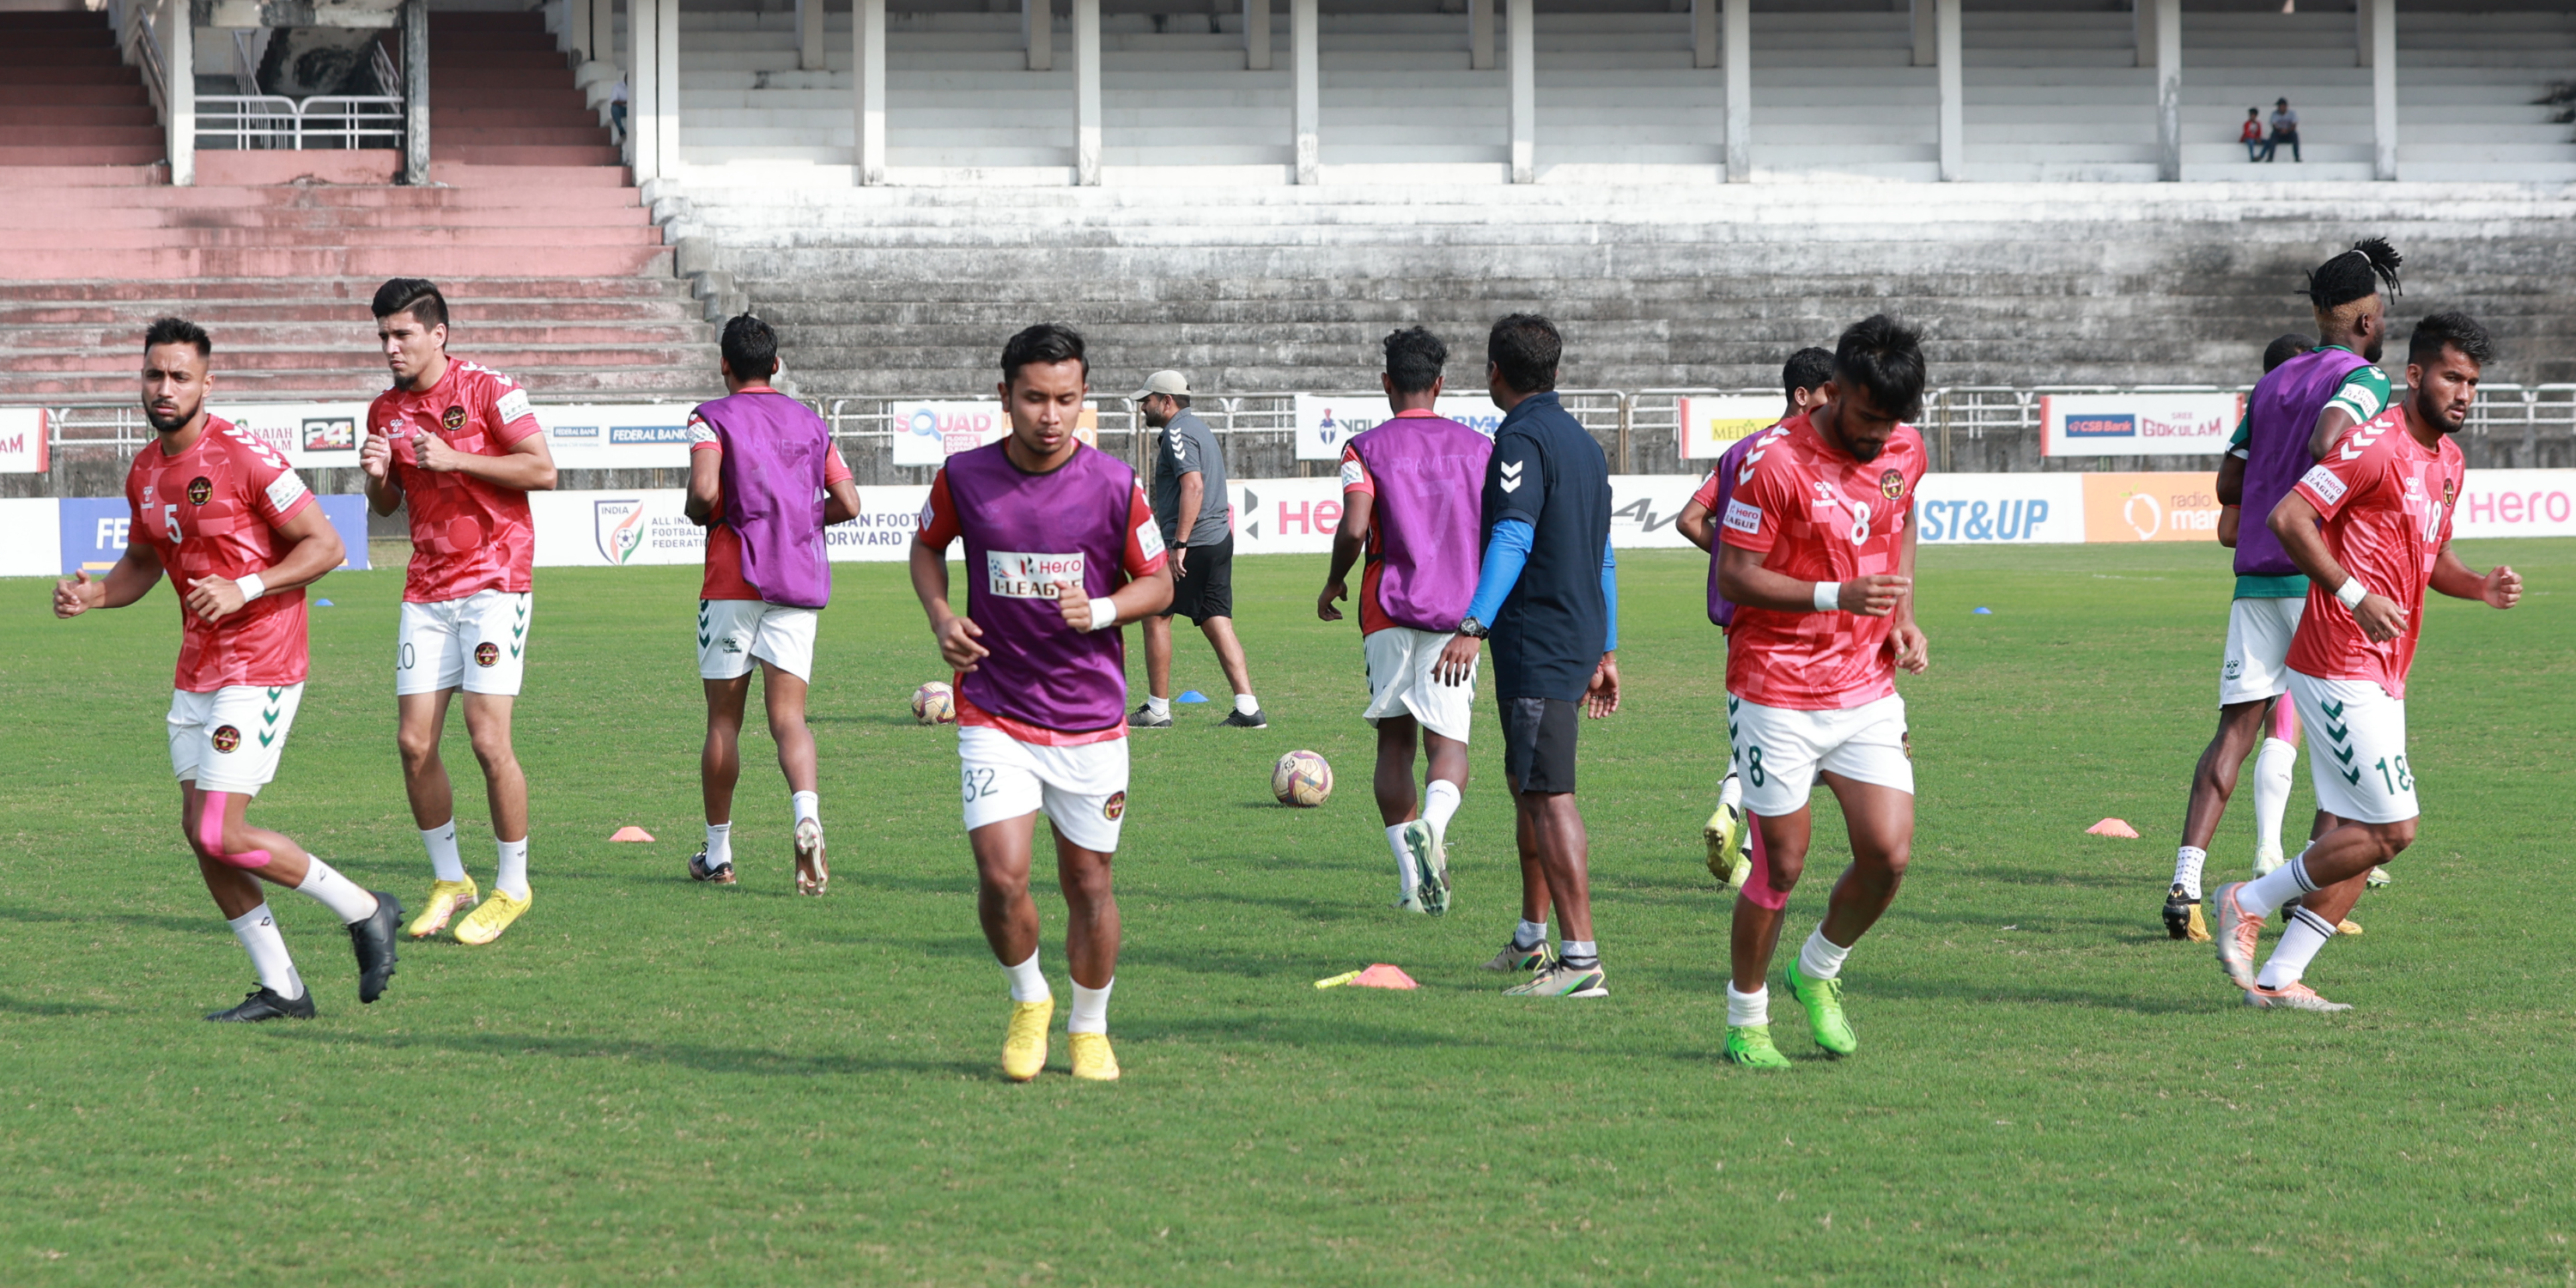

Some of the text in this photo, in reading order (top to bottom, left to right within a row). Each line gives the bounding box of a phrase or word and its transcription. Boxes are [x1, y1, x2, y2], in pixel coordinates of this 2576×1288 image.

[305, 421, 352, 445] 24
[612, 429, 656, 441] FEDERAL
[657, 428, 688, 440] BANK
[895, 409, 992, 441] SQUAD
[2081, 420, 2133, 432] CSB Bank
[2142, 417, 2222, 436] GOKULAM
[2171, 492, 2211, 507] radio
[2469, 490, 2571, 523] Hero
[164, 503, 183, 544] 5
[652, 517, 671, 526] ALL
[1735, 507, 1759, 519] Hero
[1850, 501, 1871, 546] 8
[2422, 499, 2442, 544] 18
[652, 528, 706, 537] FOOTBALL
[1040, 560, 1082, 574] Hero
[993, 578, 1081, 596] I-LEAGE
[1748, 745, 1765, 787] 8
[2375, 755, 2412, 795] 18
[963, 768, 998, 803] 32
